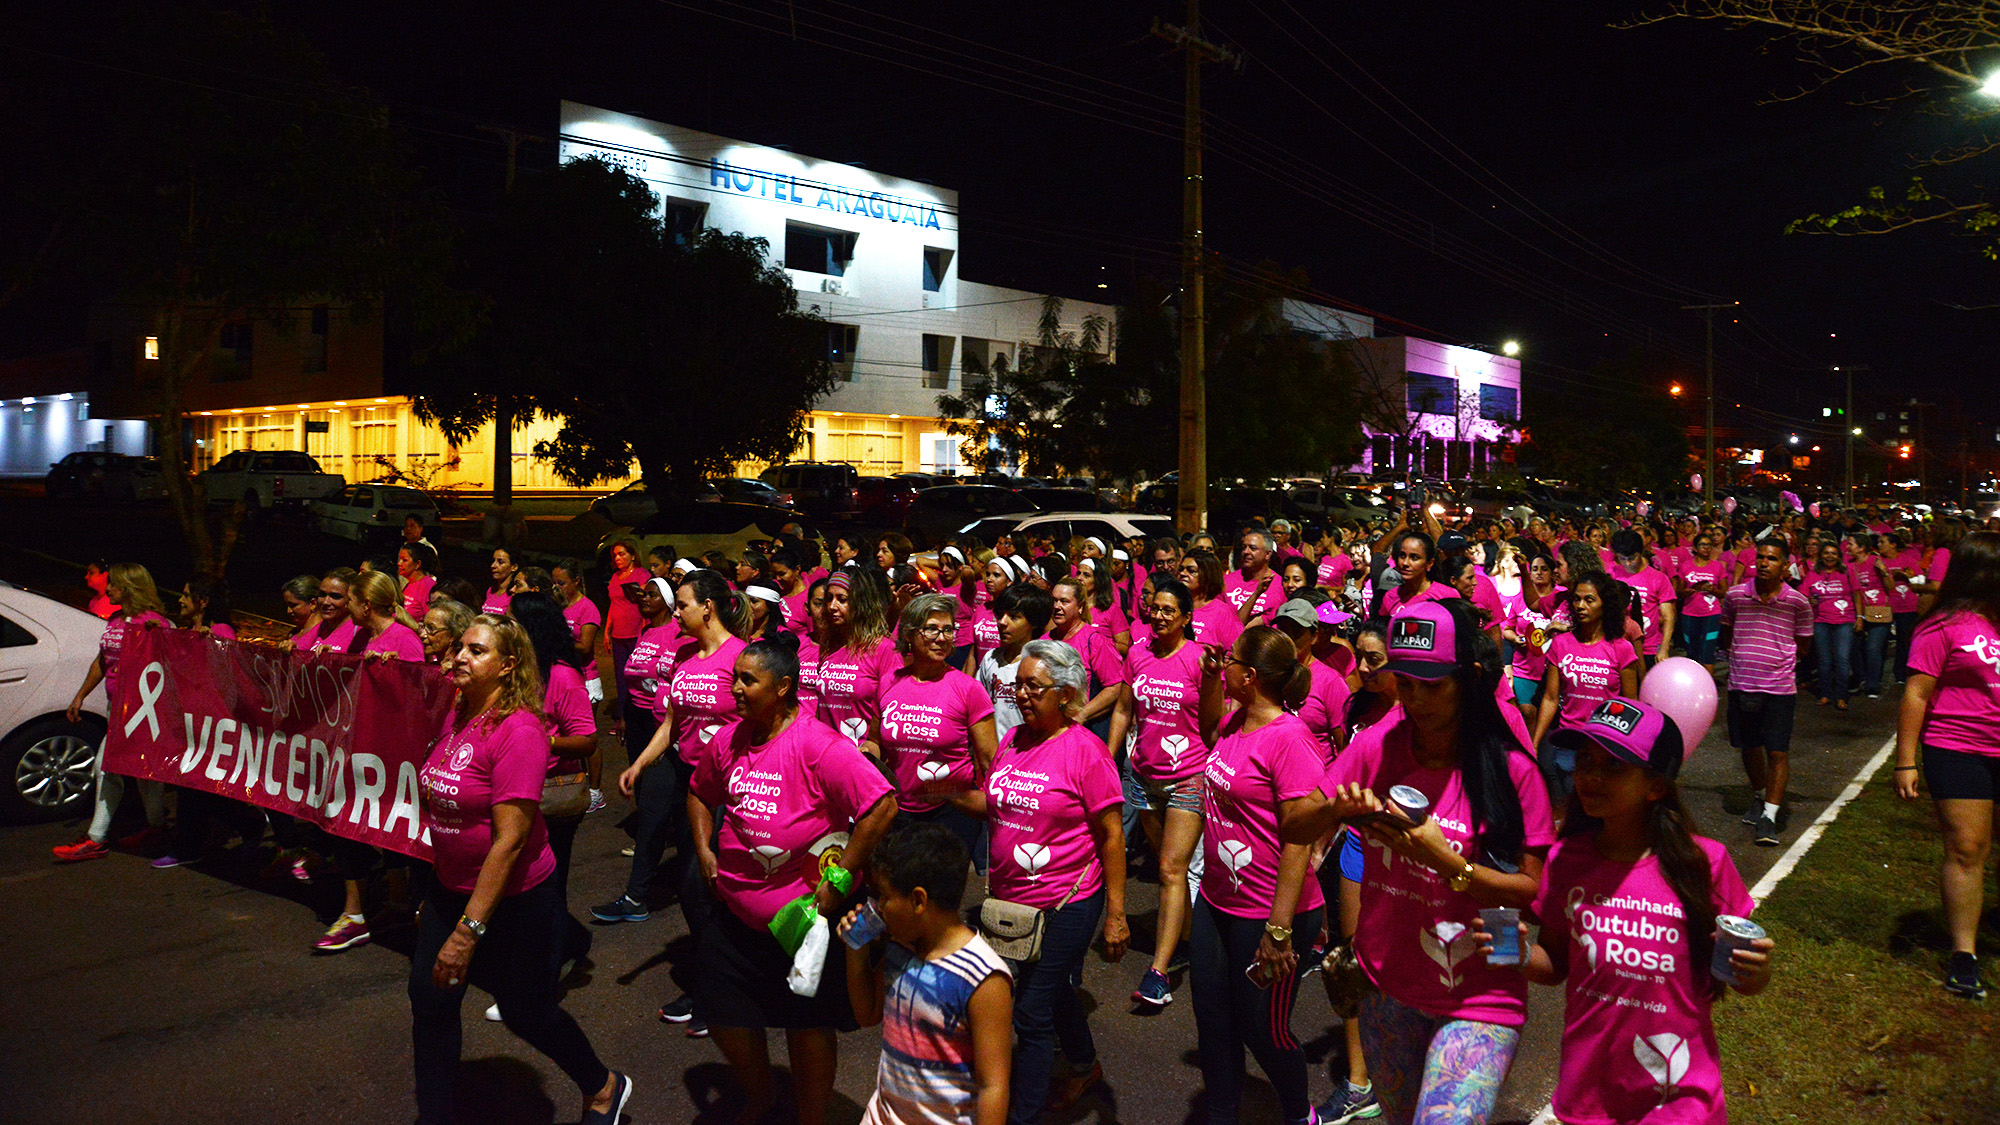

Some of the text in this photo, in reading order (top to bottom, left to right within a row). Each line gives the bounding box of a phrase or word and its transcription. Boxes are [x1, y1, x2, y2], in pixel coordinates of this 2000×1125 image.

[711, 157, 942, 231] HOTEL ARAGUAIA
[820, 670, 857, 681] Outubro
[1570, 662, 1610, 675] Outubro
[685, 673, 719, 681] Caminhada
[1148, 677, 1184, 689] Caminhada
[1580, 672, 1608, 686] Rosa
[677, 679, 718, 692] Outubro
[827, 679, 855, 693] Rosa
[1141, 685, 1183, 699] Outubro
[253, 654, 355, 732] SOMOS
[685, 691, 718, 705] Rosa
[900, 703, 943, 714] Caminhada
[1153, 696, 1181, 711] Rosa
[891, 711, 942, 725] Outubro
[902, 722, 940, 738] Rosa
[745, 770, 783, 781] minhada
[998, 775, 1045, 794] Outubro
[1006, 790, 1040, 810] Rosa
[755, 827, 772, 839] vida
[1593, 892, 1683, 919] Caminhada
[1581, 910, 1680, 944] Outubro
[1604, 938, 1676, 973] Rosa
[1615, 968, 1647, 981] Palmas
[1654, 975, 1666, 984] TO
[1616, 996, 1668, 1014] pela vida
